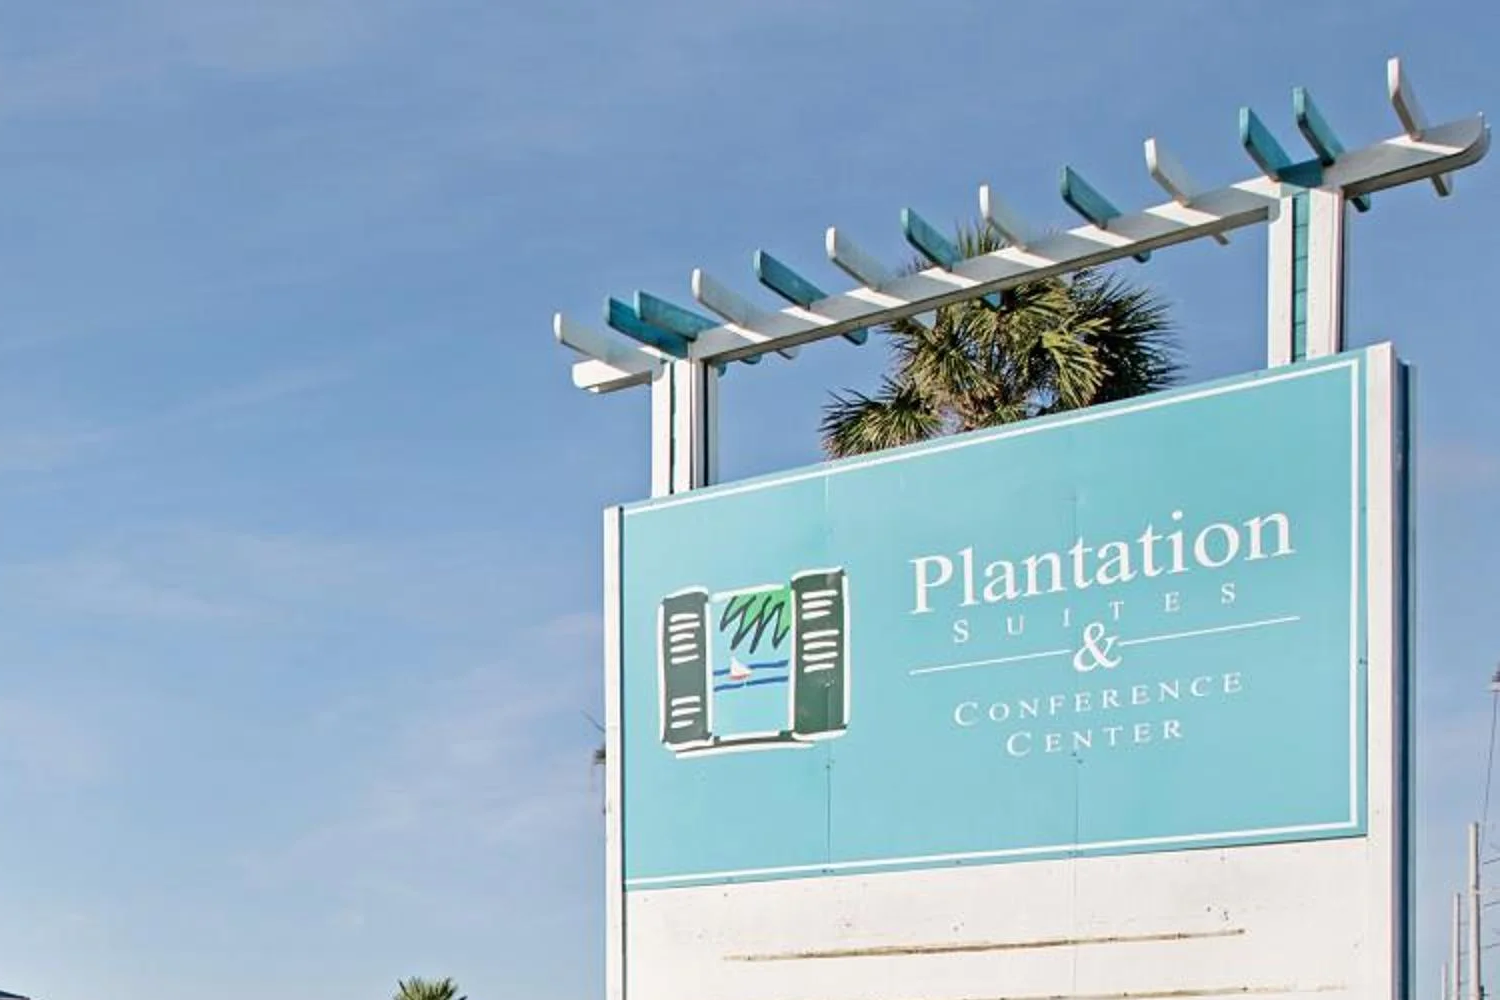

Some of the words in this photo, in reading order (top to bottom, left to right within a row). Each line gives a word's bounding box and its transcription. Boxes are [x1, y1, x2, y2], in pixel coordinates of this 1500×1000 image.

[910, 510, 1296, 614] Plantation
[953, 582, 1236, 643] SUITES
[1072, 622, 1122, 673] &
[954, 672, 1243, 727] CONFERENCE
[1006, 719, 1183, 757] CENTER
